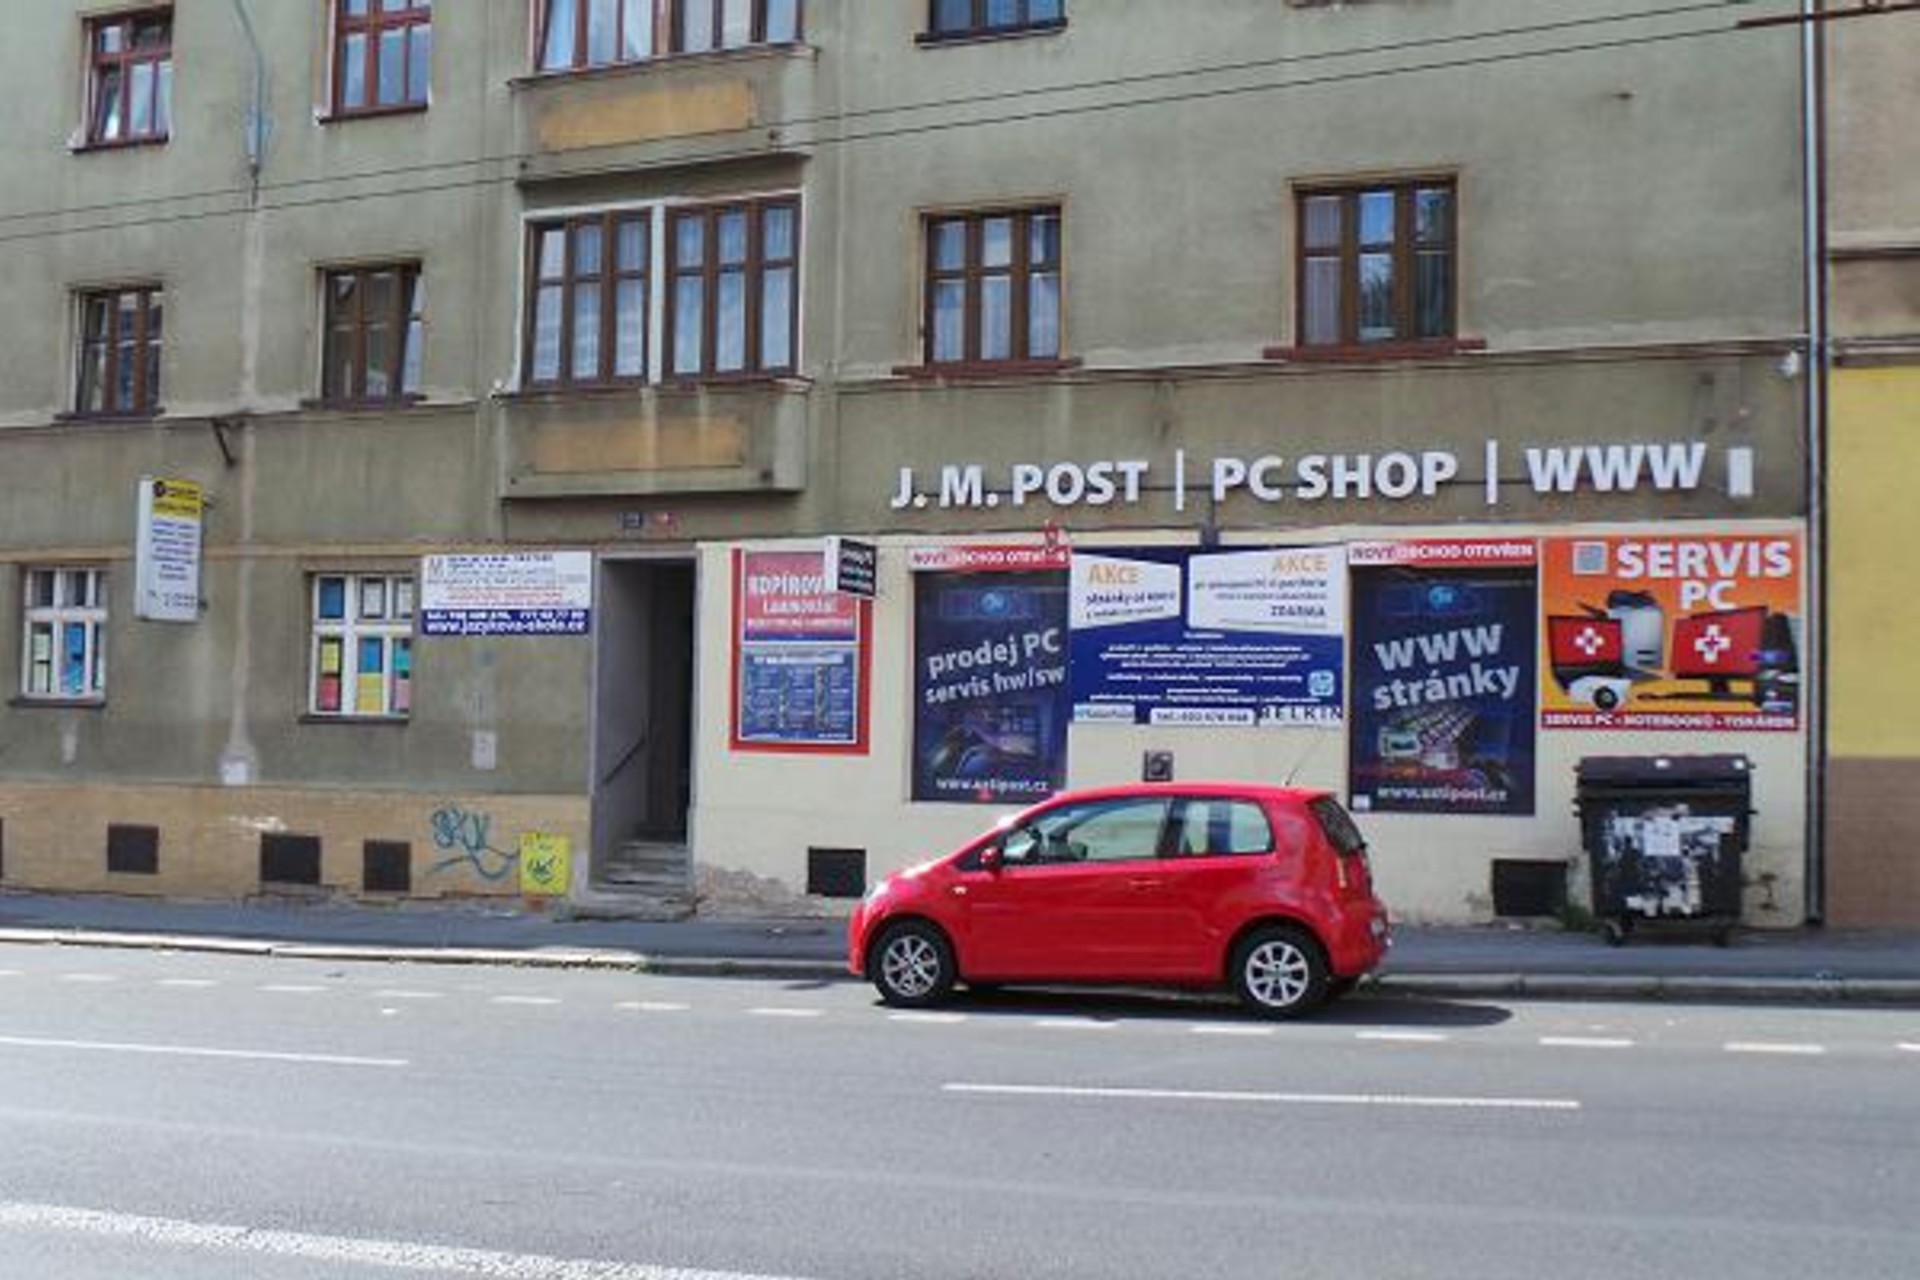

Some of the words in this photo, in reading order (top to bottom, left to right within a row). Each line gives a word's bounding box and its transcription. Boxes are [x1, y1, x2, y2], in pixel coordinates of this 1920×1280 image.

[891, 467, 928, 508] J.
[940, 465, 999, 507] M.
[1013, 461, 1148, 505] POST
[1213, 455, 1283, 501] PC
[1296, 451, 1457, 500] SHOP
[1526, 442, 1707, 492] WWW
[1616, 541, 1793, 578] SERVIS
[1680, 580, 1737, 610] PC
[928, 634, 1018, 680] prodej
[1023, 628, 1062, 657] PC
[925, 675, 991, 704] servis
[993, 666, 1066, 693] hw/sw
[1373, 663, 1520, 710] stránky
